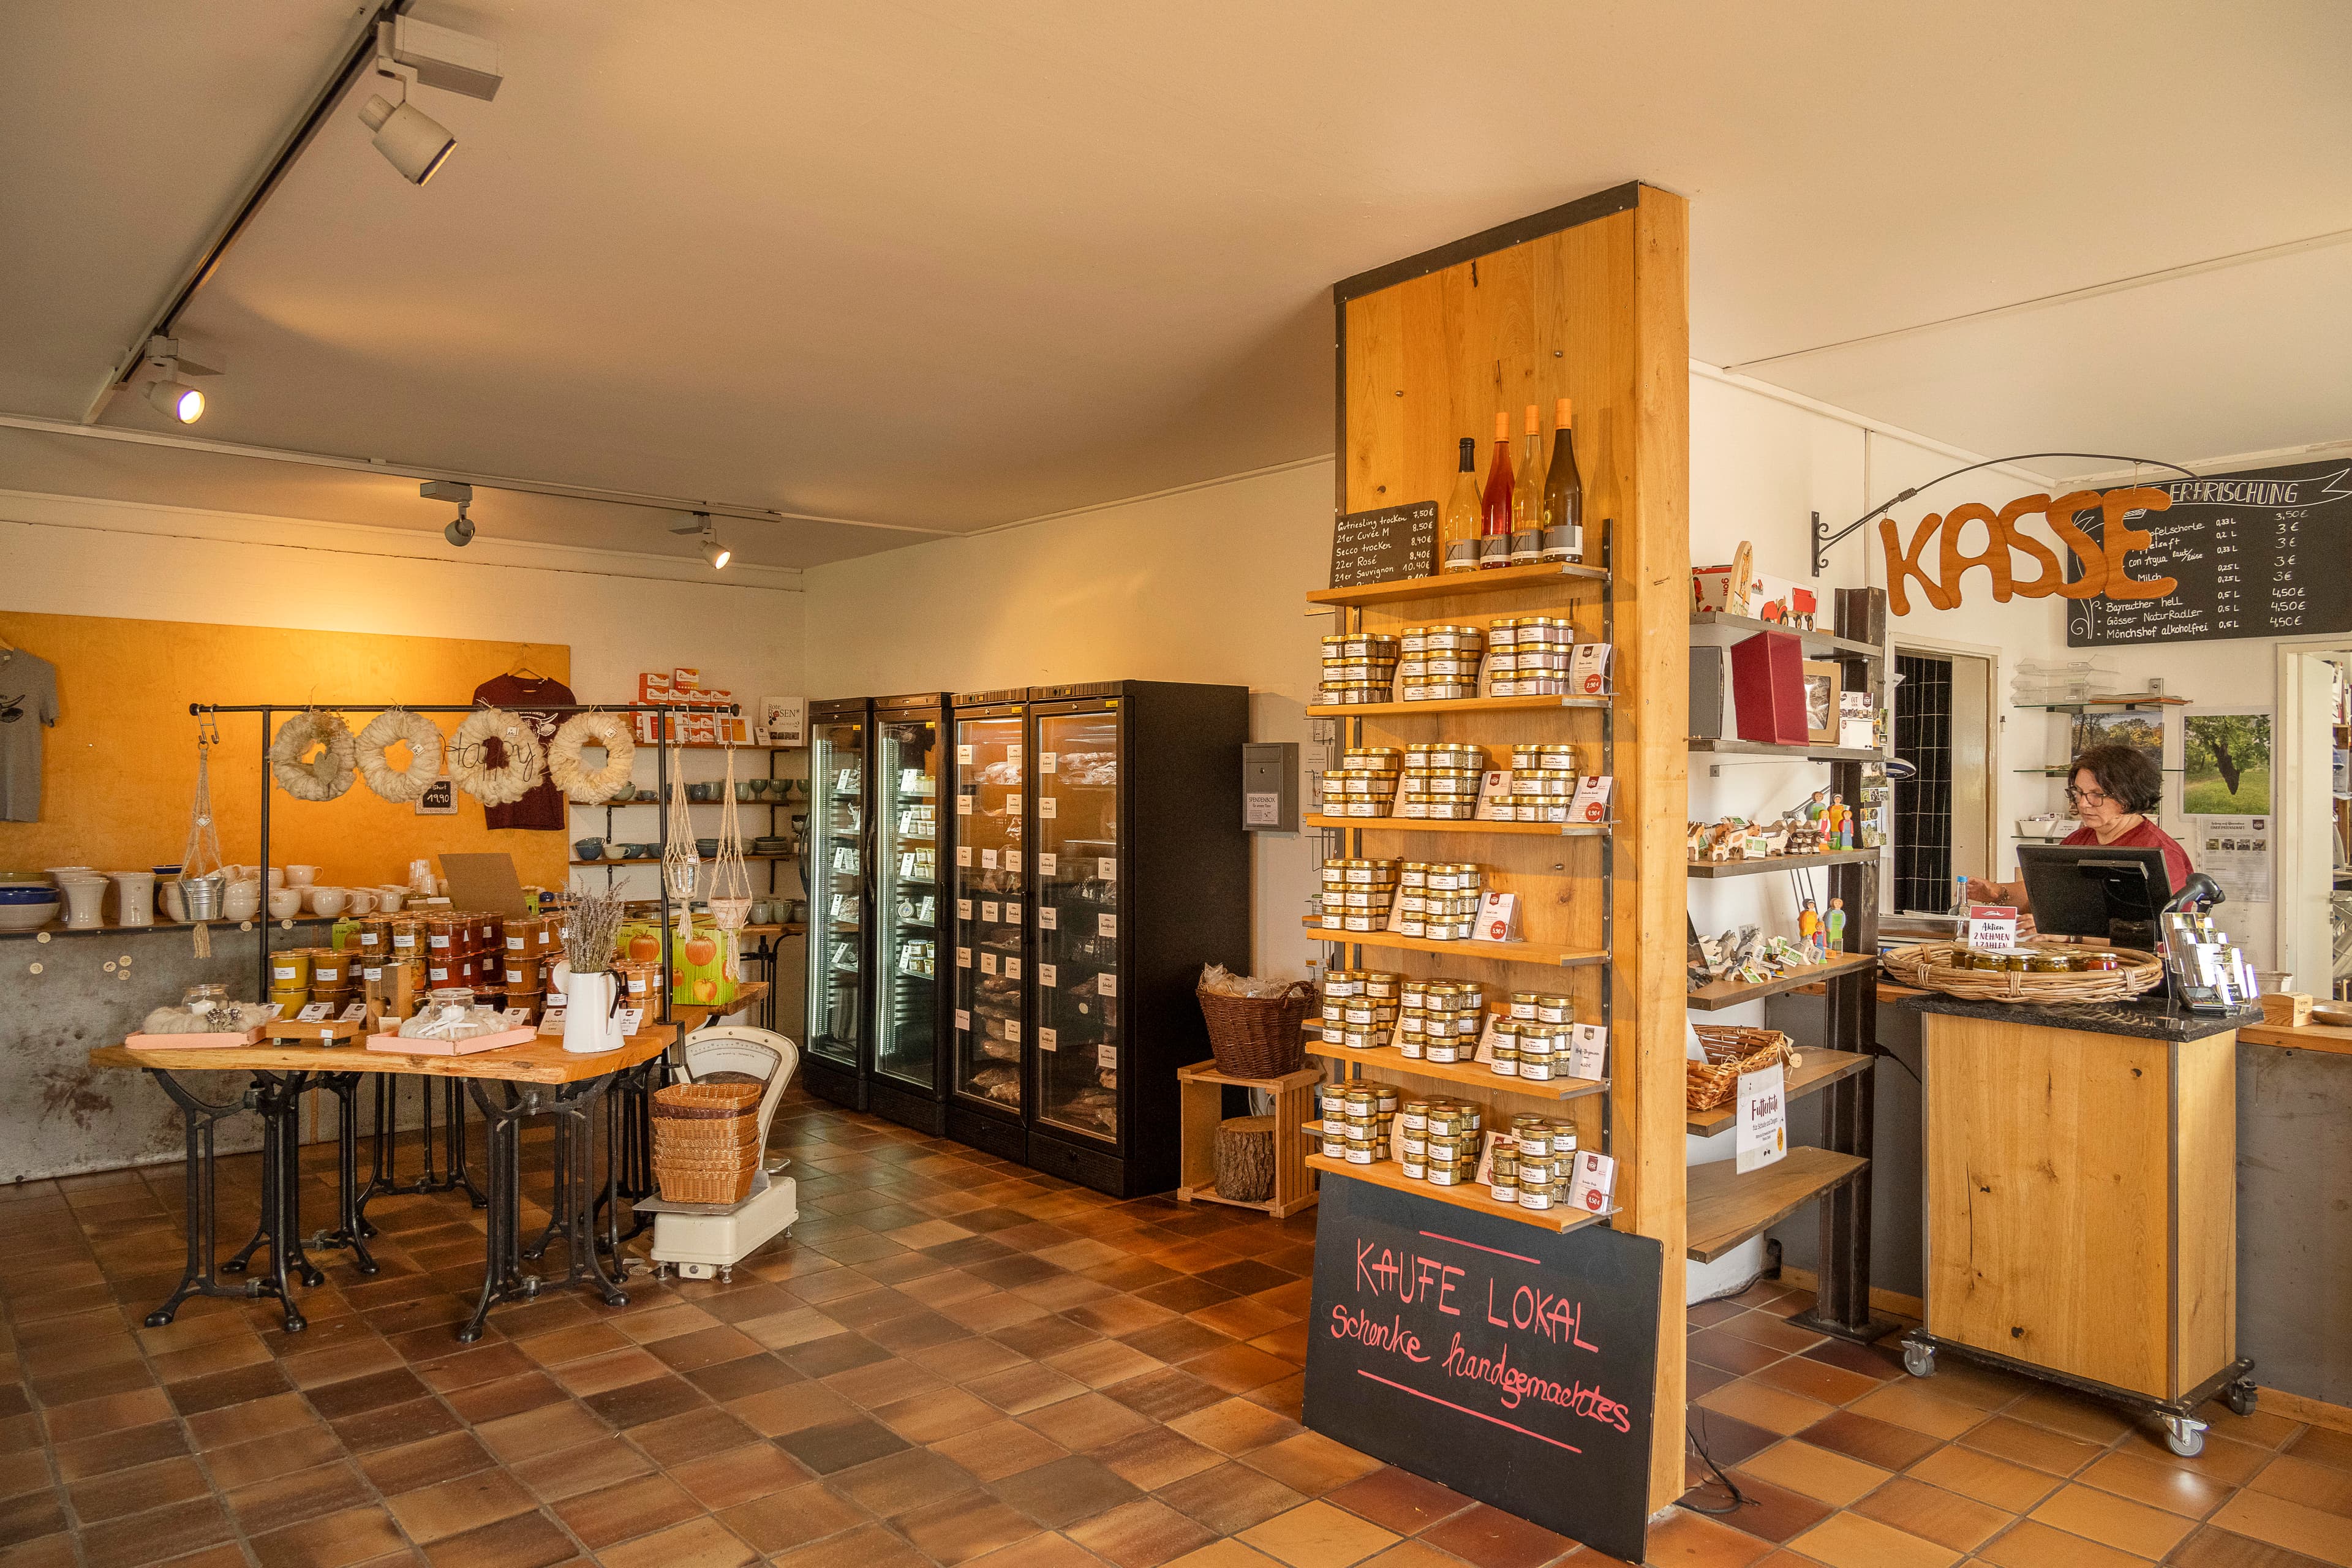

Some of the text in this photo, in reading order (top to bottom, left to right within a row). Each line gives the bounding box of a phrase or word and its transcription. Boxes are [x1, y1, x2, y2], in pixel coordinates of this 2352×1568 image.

[1338, 518, 1378, 532] Gutriesling
[1379, 515, 1408, 526] trocken
[2216, 518, 2230, 527] 0,33
[1336, 535, 1354, 544] 21er
[1357, 530, 1379, 541] Cuvée
[1382, 527, 1389, 537] M
[1336, 548, 1358, 557] Secco
[1362, 541, 1392, 552] trocken
[1879, 488, 2178, 616] KASSE
[1336, 561, 1354, 570] 22er
[1357, 554, 1378, 566] Rosé
[2144, 556, 2168, 567] Agua
[2218, 564, 2233, 572] 0,25
[1335, 573, 1352, 582] 21er
[1356, 566, 1394, 579] Sauvignon
[2106, 600, 2154, 615] Bayreuther
[2218, 590, 2230, 599] 0,5
[2106, 615, 2138, 626] Gösser
[2218, 605, 2230, 613] 0,5
[2106, 625, 2157, 639] Mönchshof
[2161, 622, 2208, 635] alkoholfrei
[1982, 922, 2005, 931] Aktion
[1980, 932, 2010, 941] NEHMEN
[1752, 1094, 1778, 1121] Futtertüte
[1357, 1237, 1466, 1316] KAUFE
[1487, 1277, 1599, 1353] LOKAL
[1441, 1331, 1630, 1433] handgemachtes
